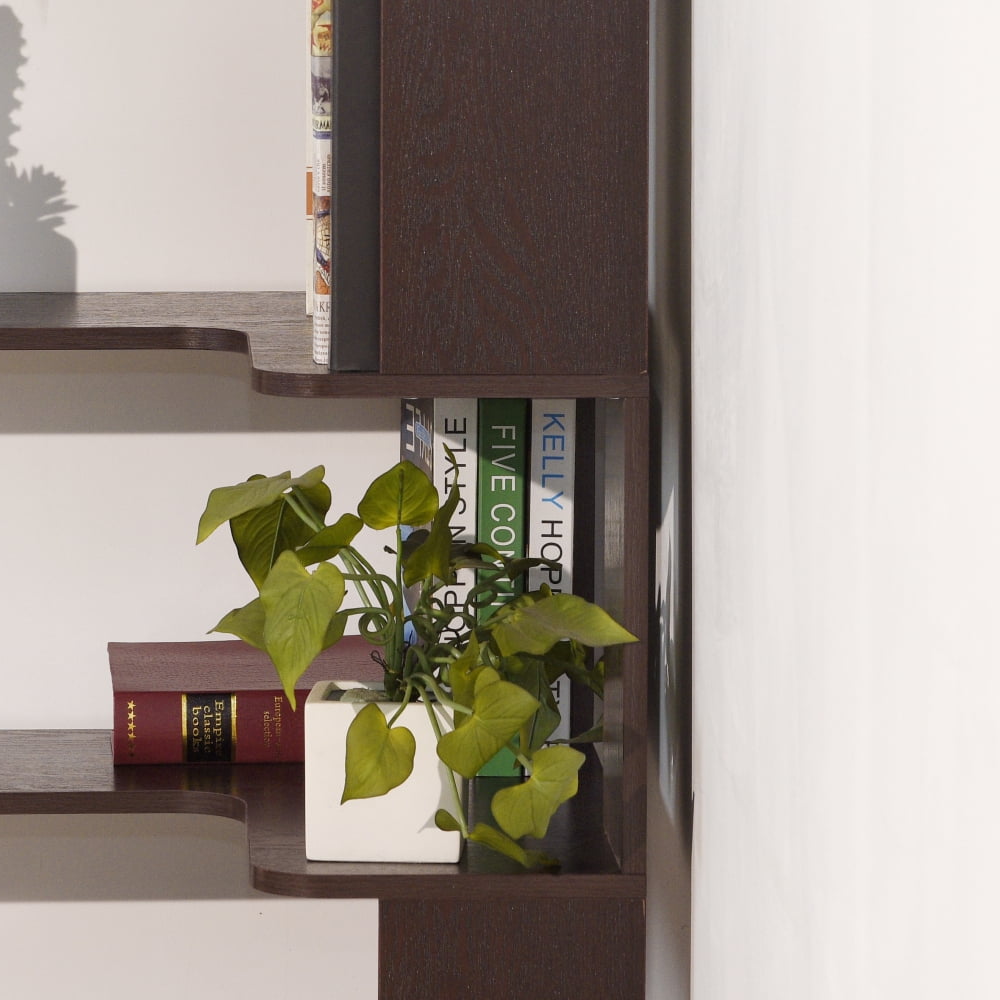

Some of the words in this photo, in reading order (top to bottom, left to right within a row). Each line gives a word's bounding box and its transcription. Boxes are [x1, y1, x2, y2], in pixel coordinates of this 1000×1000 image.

[490, 425, 516, 492] FIVE
[541, 413, 565, 510] KELLY
[191, 706, 202, 753] books
[203, 705, 214, 753] classic
[213, 699, 225, 757] Empire
